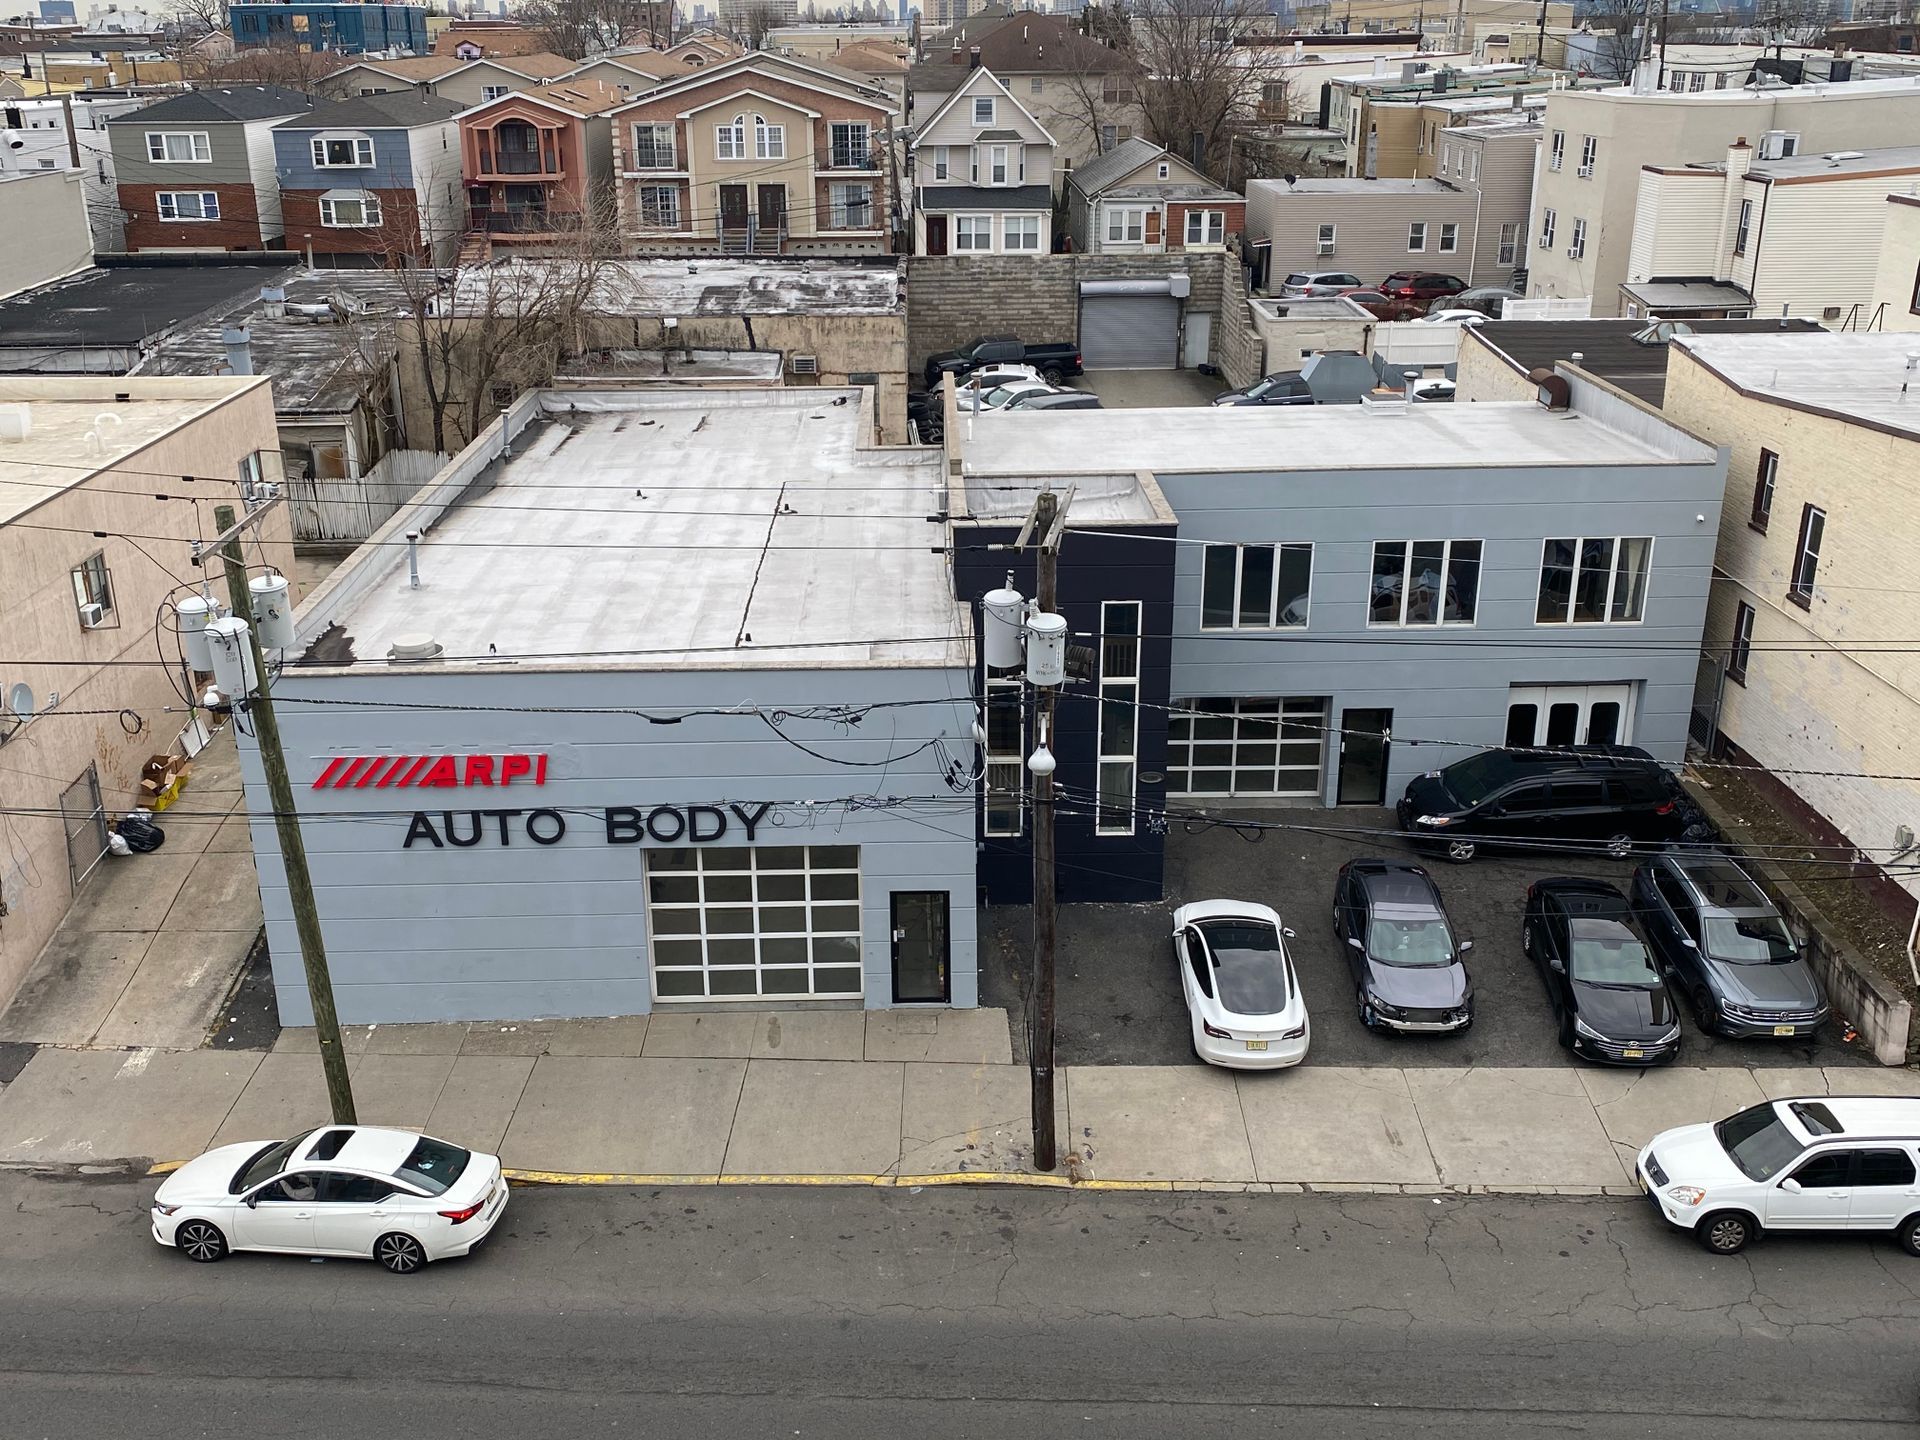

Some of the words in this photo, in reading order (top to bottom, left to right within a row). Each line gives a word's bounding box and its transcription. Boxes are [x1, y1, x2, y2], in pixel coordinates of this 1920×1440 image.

[417, 753, 548, 788] ARPI
[402, 809, 566, 849] AUTO
[605, 801, 775, 844] BODY
